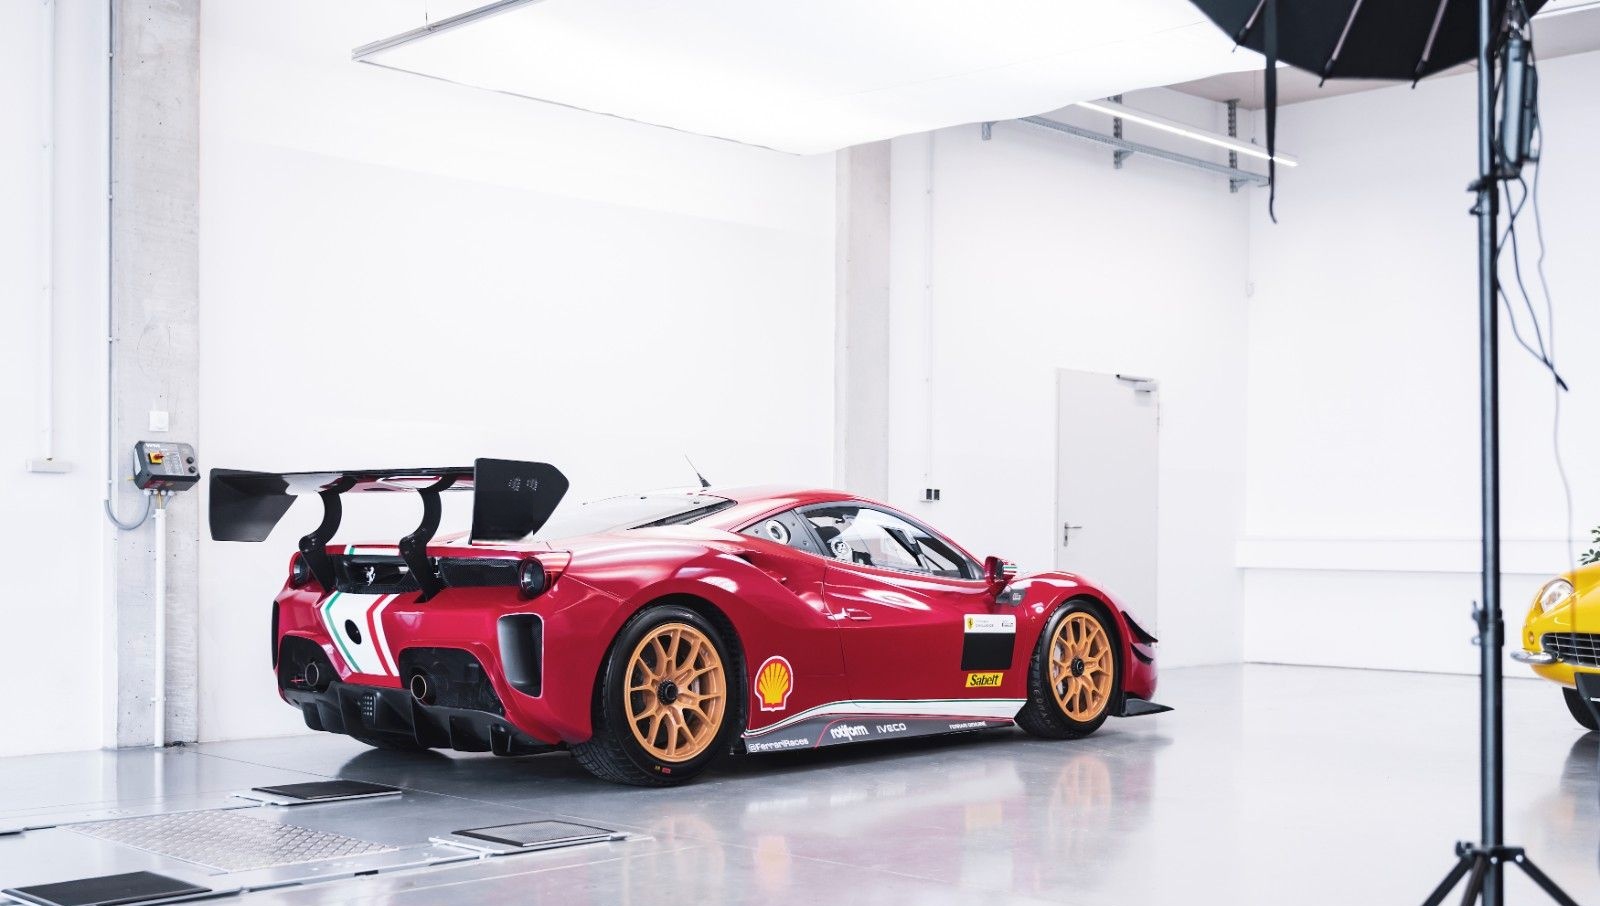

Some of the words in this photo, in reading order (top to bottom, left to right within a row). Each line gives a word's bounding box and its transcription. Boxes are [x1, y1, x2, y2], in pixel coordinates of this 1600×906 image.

[969, 673, 999, 686] Sabelt
[830, 724, 870, 741] rotiform
[876, 722, 907, 734] IVECO
[748, 737, 809, 753] @FerrariRaces
